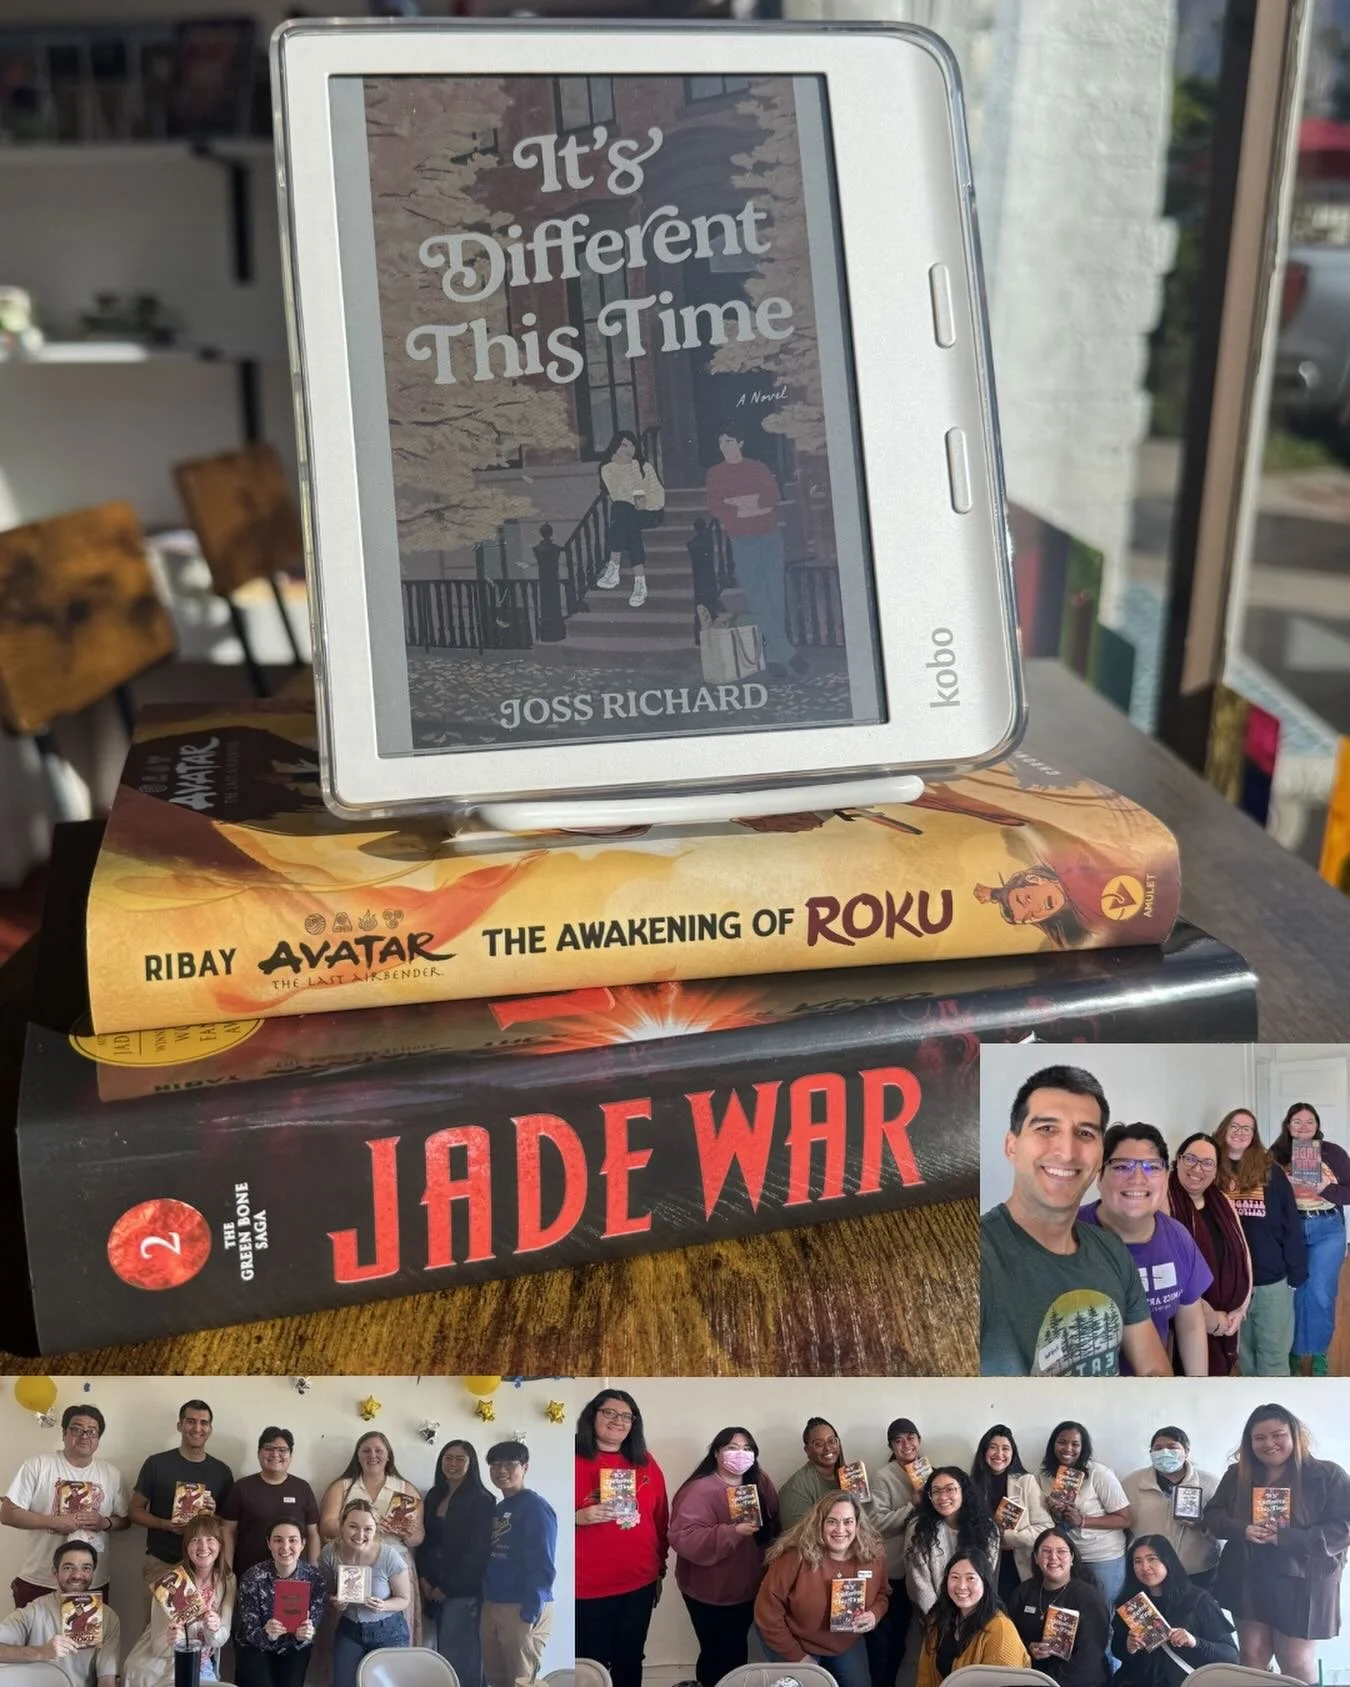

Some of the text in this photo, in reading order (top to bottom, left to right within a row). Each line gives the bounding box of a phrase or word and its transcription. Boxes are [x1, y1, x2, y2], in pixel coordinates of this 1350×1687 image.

[512, 126, 663, 196] It's
[418, 200, 772, 303] Different
[405, 290, 795, 385] This Time
[736, 384, 788, 408] A Novel
[926, 627, 960, 708] kobo
[499, 682, 769, 731] JOSS RICHARD
[168, 736, 221, 810] AVATAR
[1143, 873, 1158, 918] AMULET
[481, 889, 954, 957] THE AWAKENING OF ROKU
[144, 931, 457, 982] RIBAY AVATAR
[272, 966, 441, 991] THE LAST AIRBENDER
[114, 1034, 132, 1056] JAD
[326, 1066, 926, 1284] JADE WAR
[140, 1231, 182, 1260] 2
[222, 1221, 236, 1251] THE
[234, 1181, 255, 1282] GREEN BONE
[253, 1208, 269, 1251] SAGA
